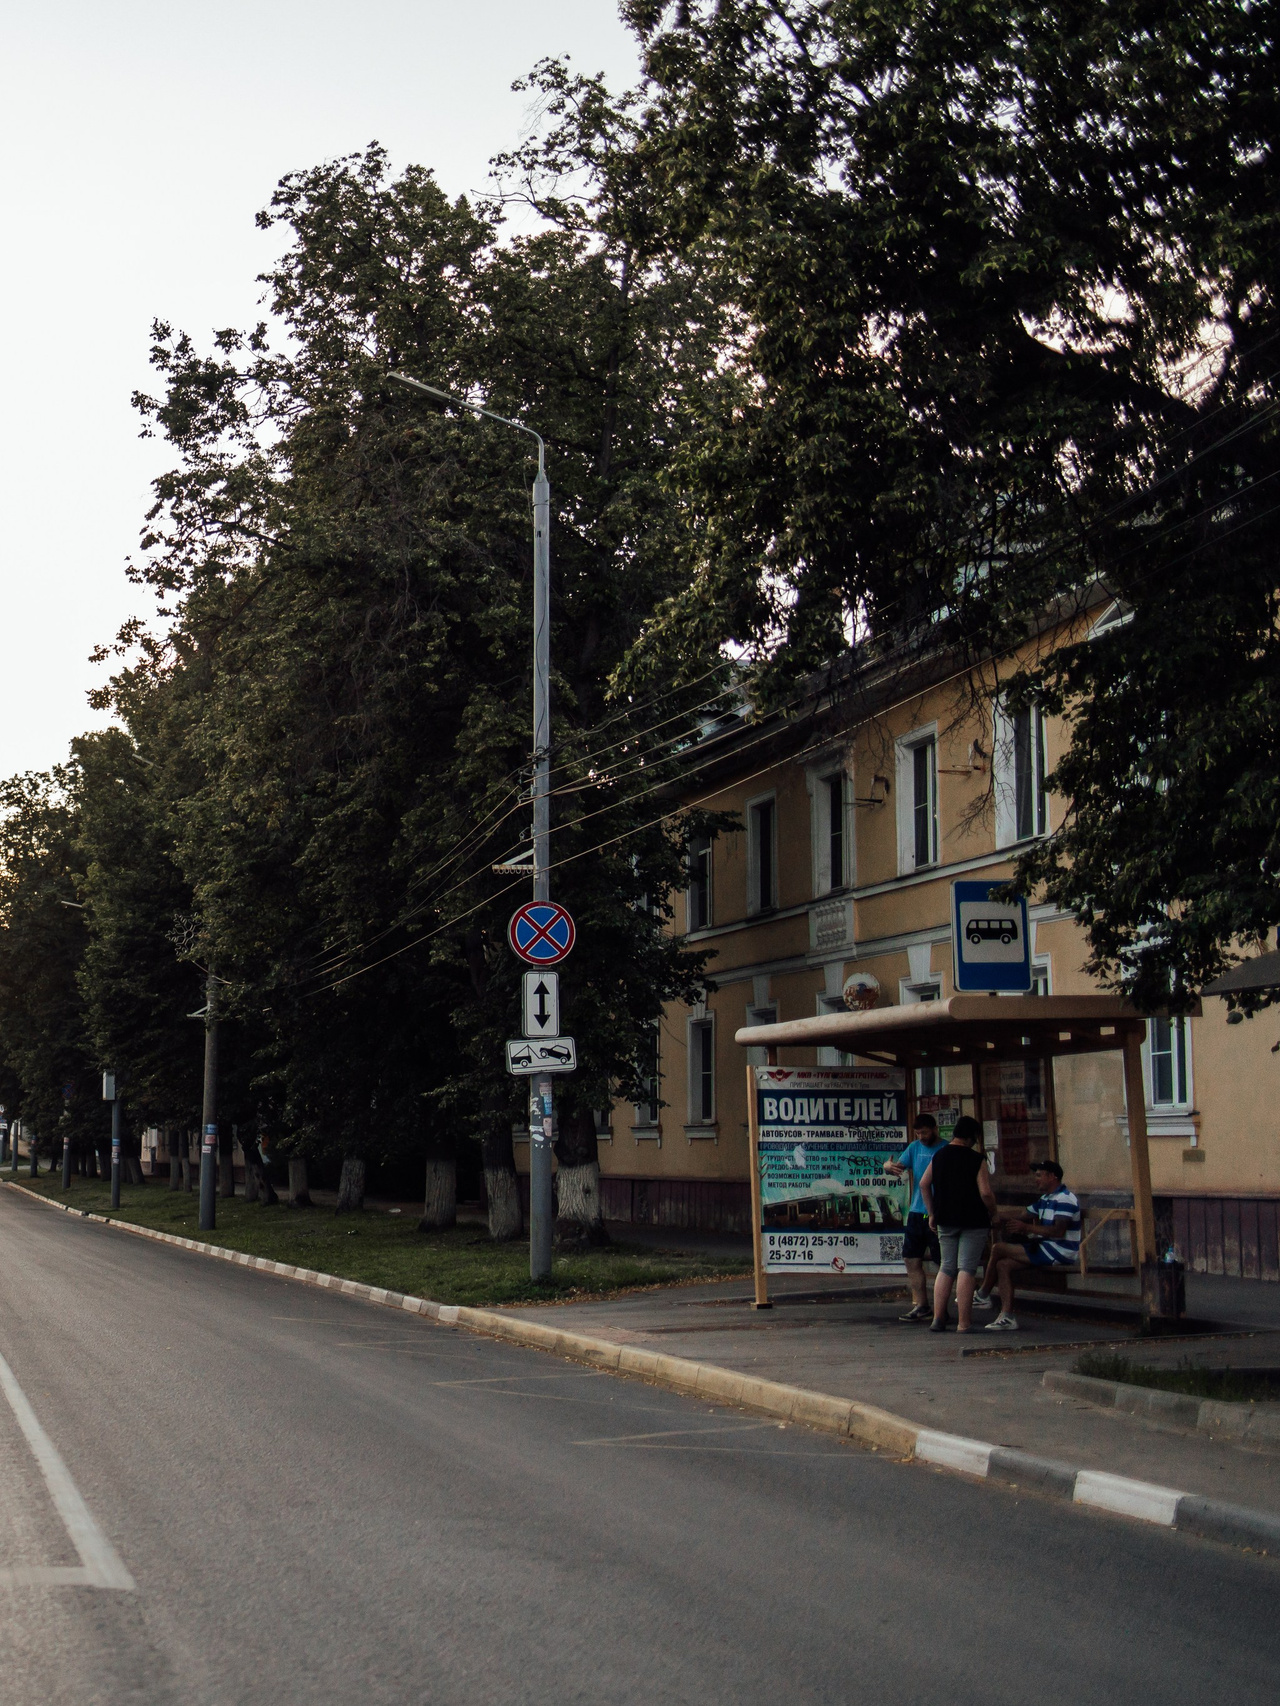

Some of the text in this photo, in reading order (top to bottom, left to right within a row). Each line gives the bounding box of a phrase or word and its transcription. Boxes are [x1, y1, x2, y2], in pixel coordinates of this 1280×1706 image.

[763, 1092, 898, 1123] ВОДИТЕЛЕЙ
[762, 1130, 802, 1138] АВТОБУСОВ
[807, 1130, 844, 1138] ТРАМВАЕВ
[800, 1142, 829, 1150] БУЧЕНИЕ
[874, 1167, 883, 1175] 50
[844, 1177, 905, 1188] до 100 000 руб.
[769, 1235, 859, 1248] 8 (4872) 25-37-08;
[769, 1250, 814, 1260] 25-37-16
